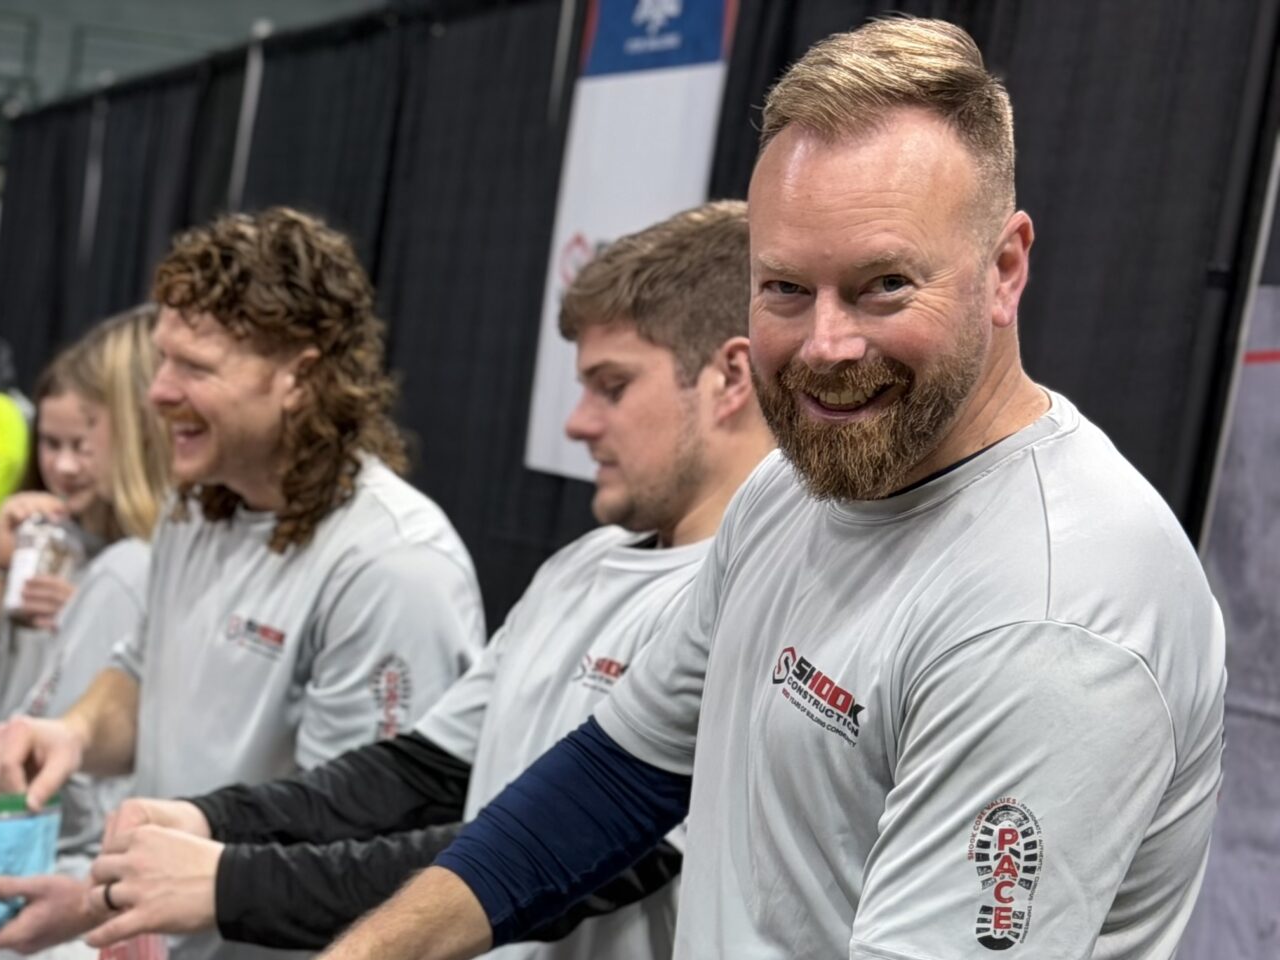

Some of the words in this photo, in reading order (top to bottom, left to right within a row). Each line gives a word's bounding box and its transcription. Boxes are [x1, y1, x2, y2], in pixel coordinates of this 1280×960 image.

[787, 676, 859, 738] CONSTRUCTION
[792, 655, 865, 727] SHOOK
[967, 832, 977, 860] SHOOK
[987, 797, 1017, 811] VALUES
[993, 828, 1019, 930] PACE
